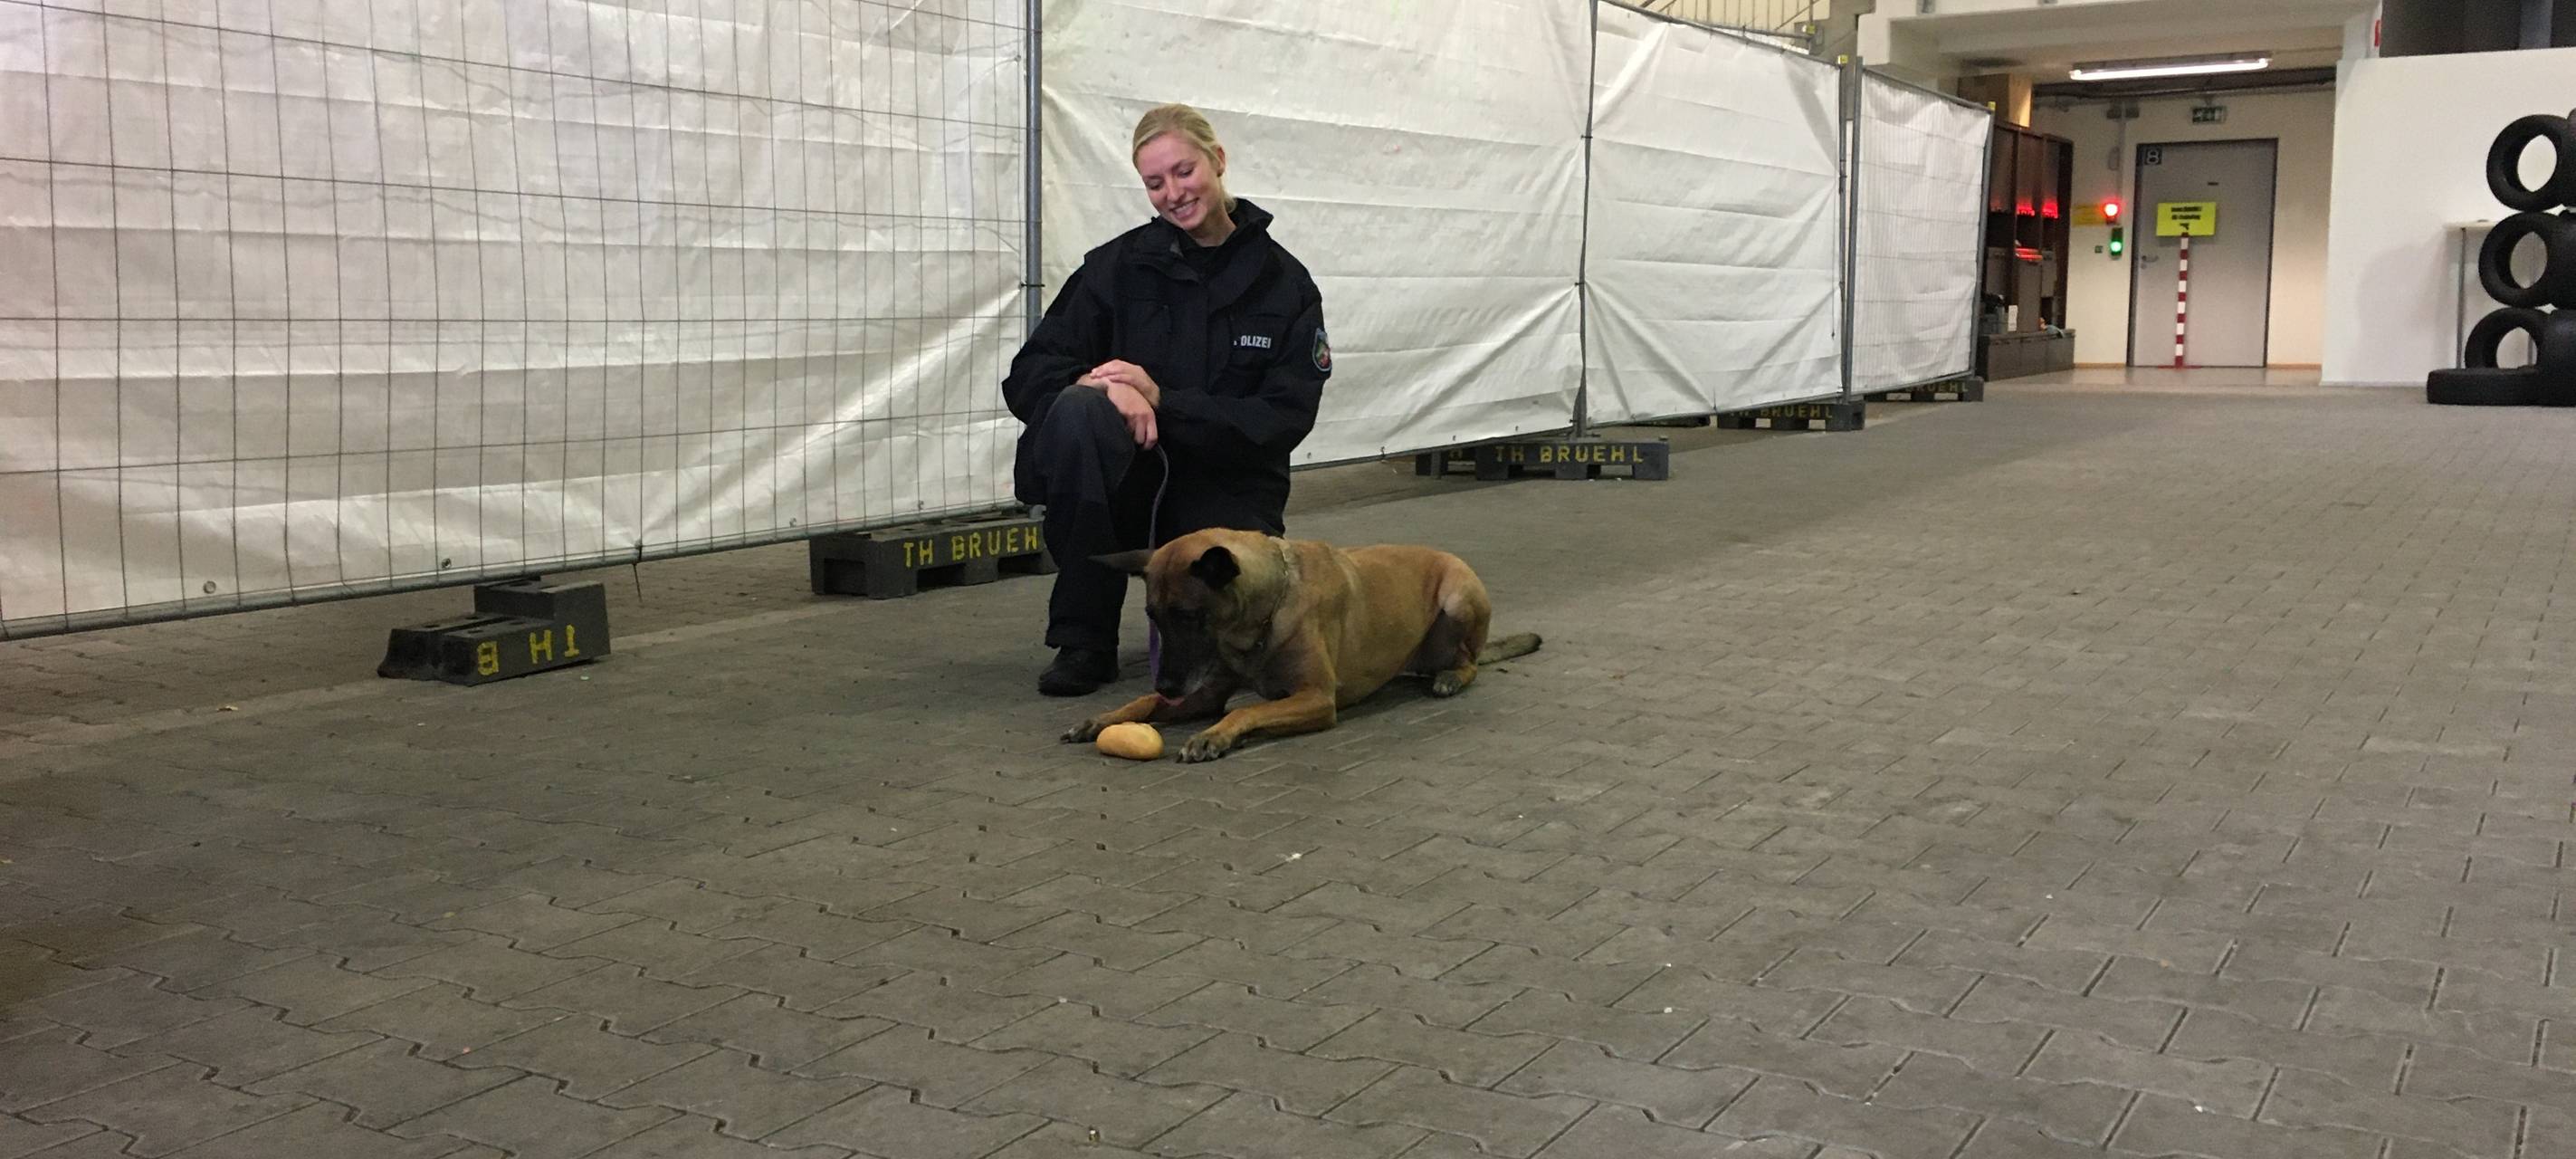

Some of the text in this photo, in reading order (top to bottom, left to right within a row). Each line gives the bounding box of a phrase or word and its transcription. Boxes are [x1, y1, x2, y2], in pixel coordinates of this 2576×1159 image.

[1495, 444, 1644, 463] TH BRUEHL
[903, 526, 1037, 568] TH BRUEH
